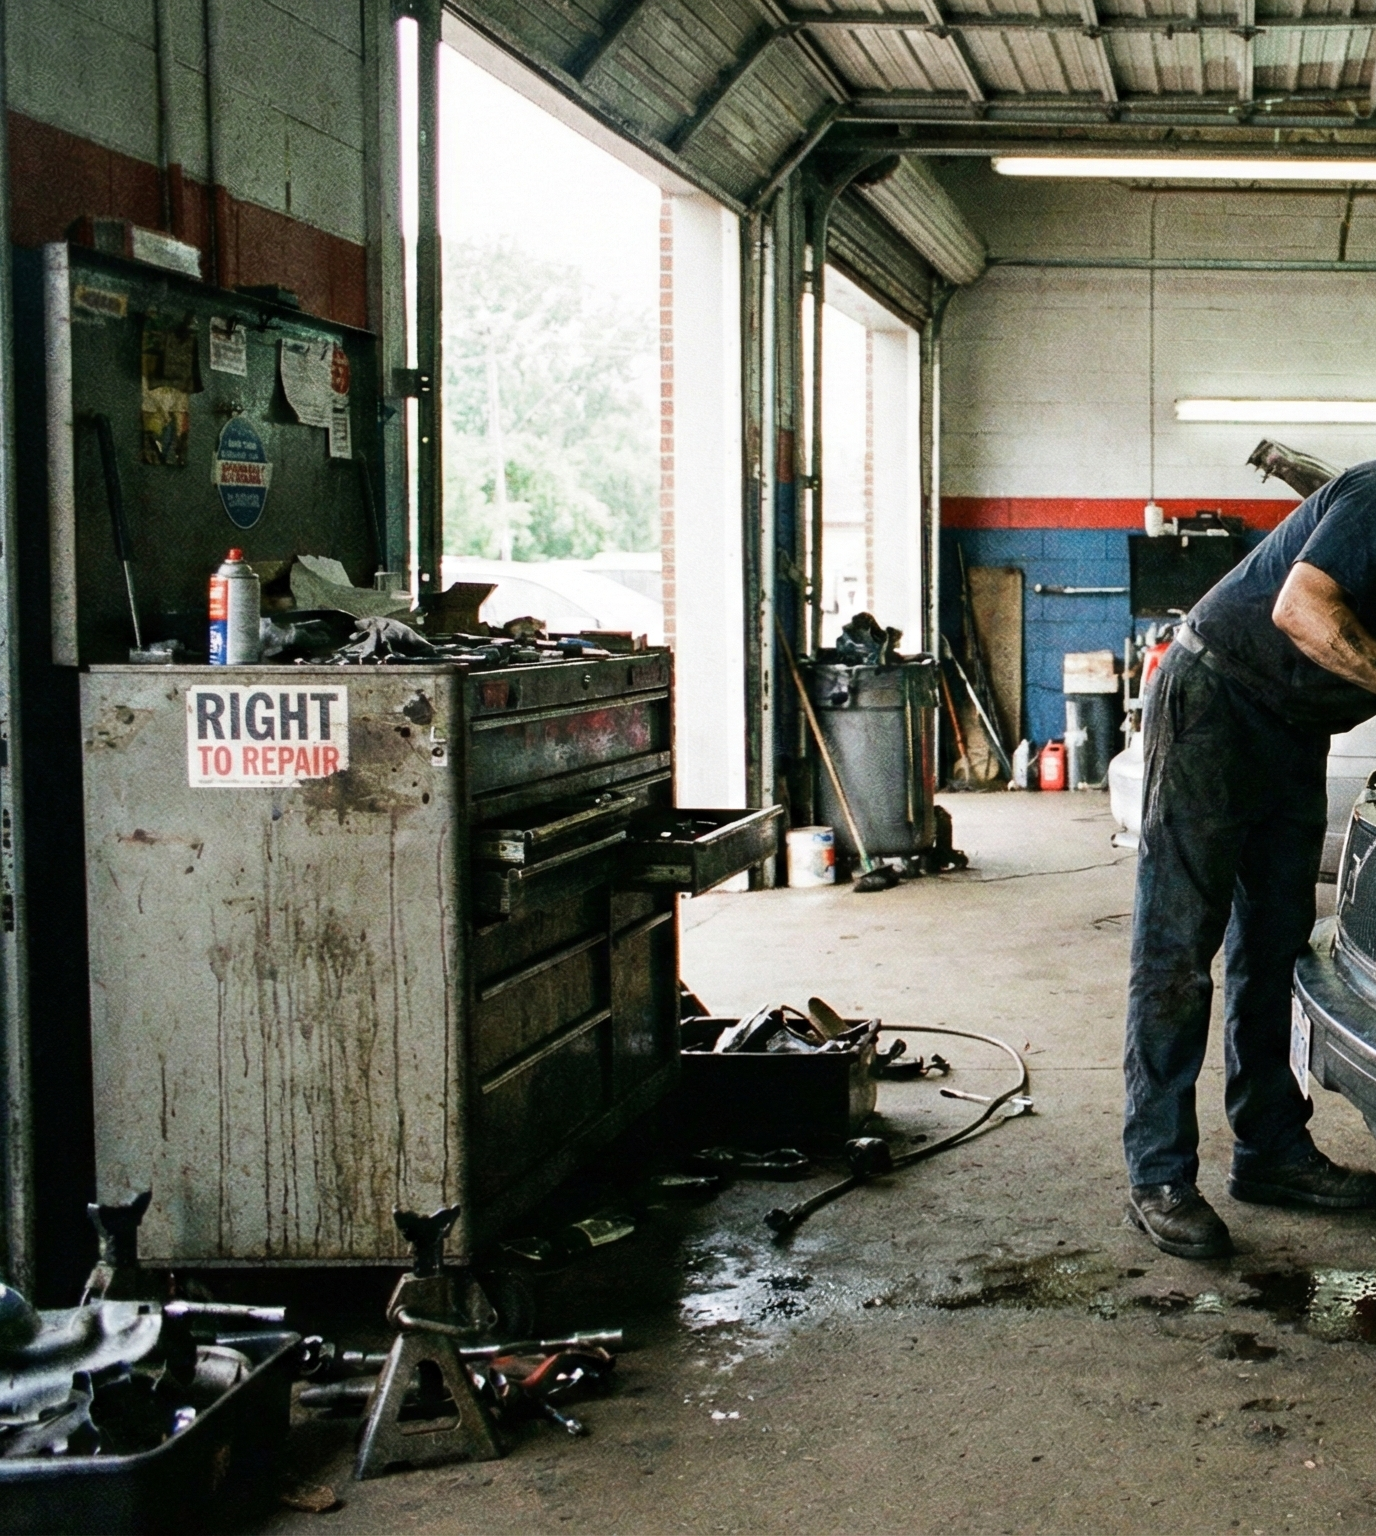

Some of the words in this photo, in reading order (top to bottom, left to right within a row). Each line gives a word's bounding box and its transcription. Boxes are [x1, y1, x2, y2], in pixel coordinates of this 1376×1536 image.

[196, 692, 339, 741] RIGHT
[197, 745, 233, 776] TO
[242, 745, 340, 777] REPAIR
